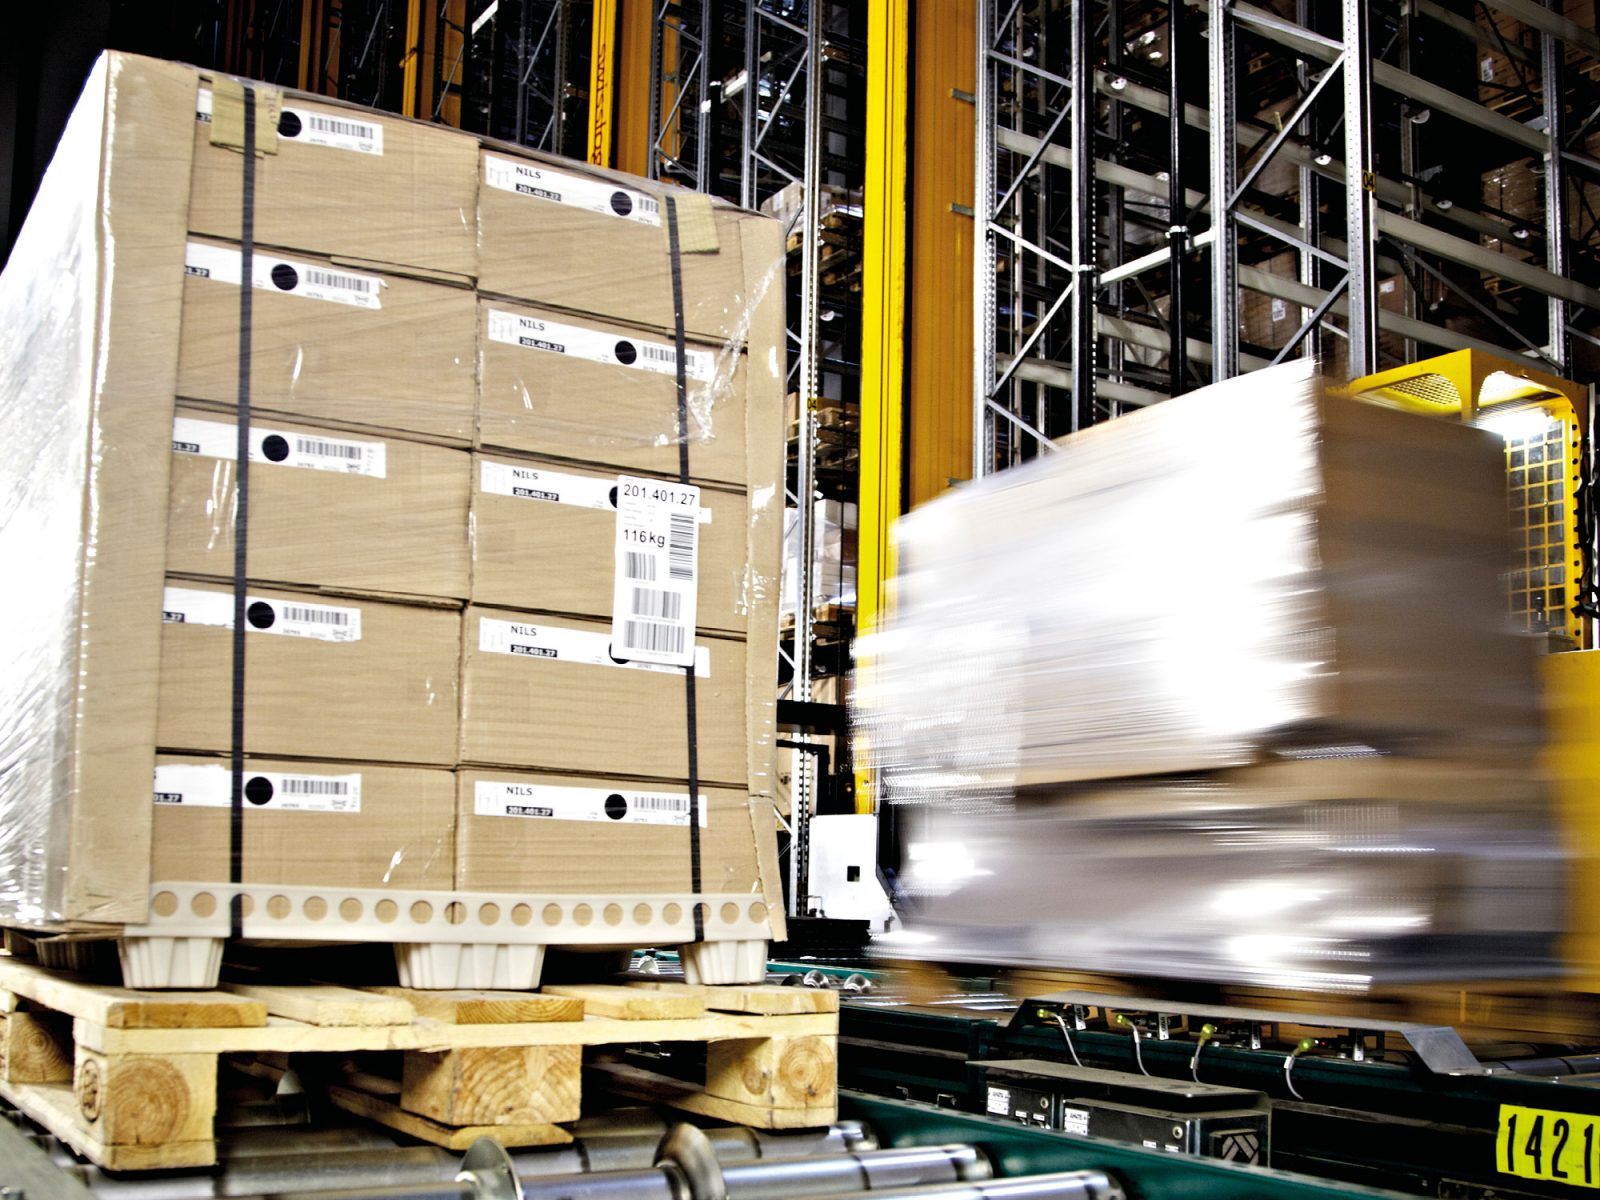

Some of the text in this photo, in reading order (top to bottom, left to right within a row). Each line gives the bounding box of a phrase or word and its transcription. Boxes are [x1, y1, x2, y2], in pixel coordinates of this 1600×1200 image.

[516, 166, 541, 179] NILS
[520, 319, 545, 331] NILS
[513, 470, 538, 480] NILS
[624, 484, 696, 505] 201.401.27
[624, 529, 665, 548] 116kg
[511, 626, 537, 636] NILS
[507, 787, 532, 796] NILS
